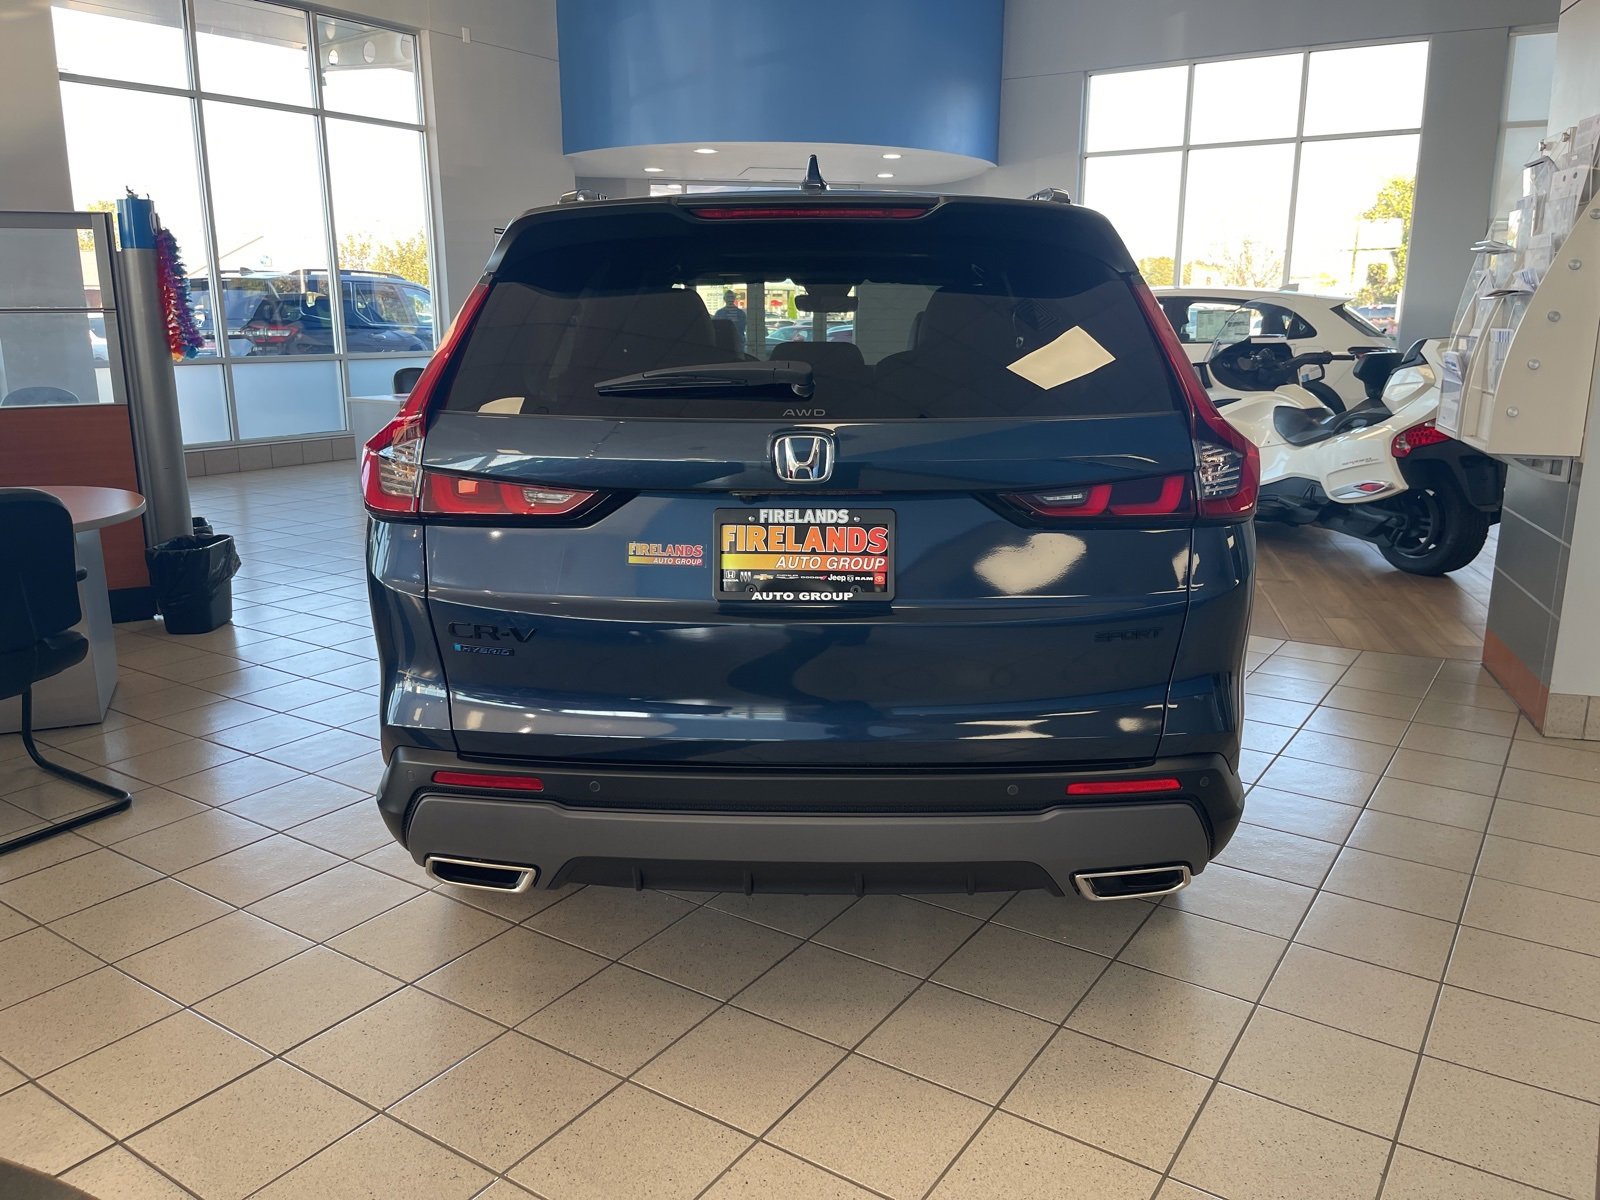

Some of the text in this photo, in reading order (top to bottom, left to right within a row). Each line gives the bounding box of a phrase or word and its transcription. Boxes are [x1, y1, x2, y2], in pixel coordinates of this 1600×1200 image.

[782, 408, 826, 417] AWD
[759, 508, 850, 524] FIRELANDS
[722, 524, 889, 554] FIRELANDS
[628, 542, 703, 557] FIRELANDS
[652, 557, 702, 566] AUTO GROUP
[775, 556, 886, 570] AUTO GROUP
[828, 573, 847, 582] Jeep
[752, 591, 854, 601] AUTO GROUP
[448, 622, 537, 643] CR-V
